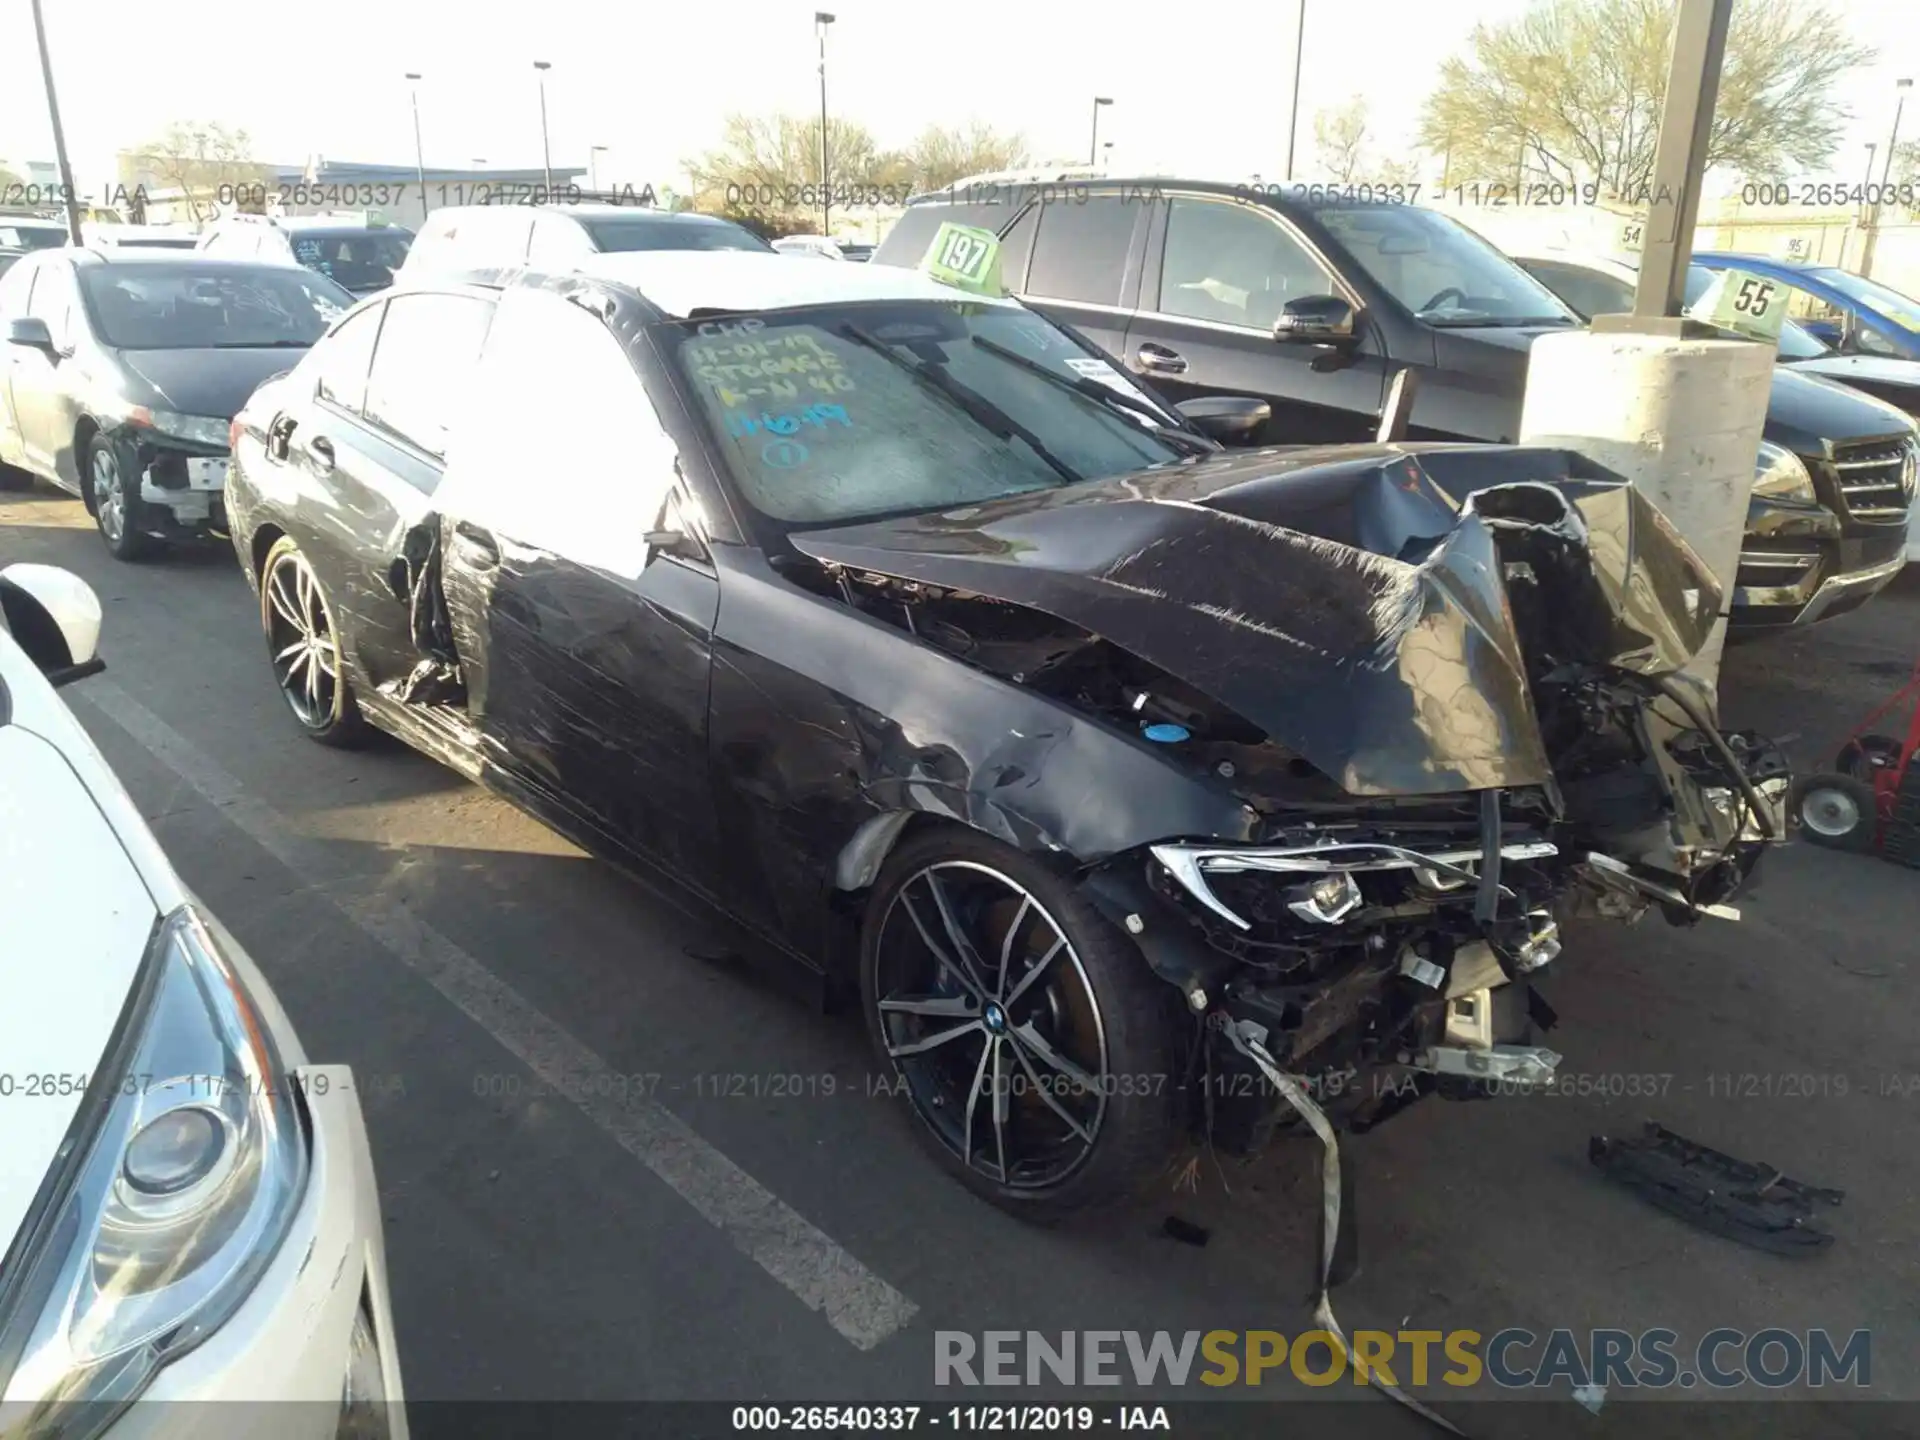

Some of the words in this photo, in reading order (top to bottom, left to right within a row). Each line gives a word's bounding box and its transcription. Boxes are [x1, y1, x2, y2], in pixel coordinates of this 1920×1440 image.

[941, 230, 988, 274] 197
[1622, 226, 1642, 243] 54
[1734, 279, 1775, 318] 55
